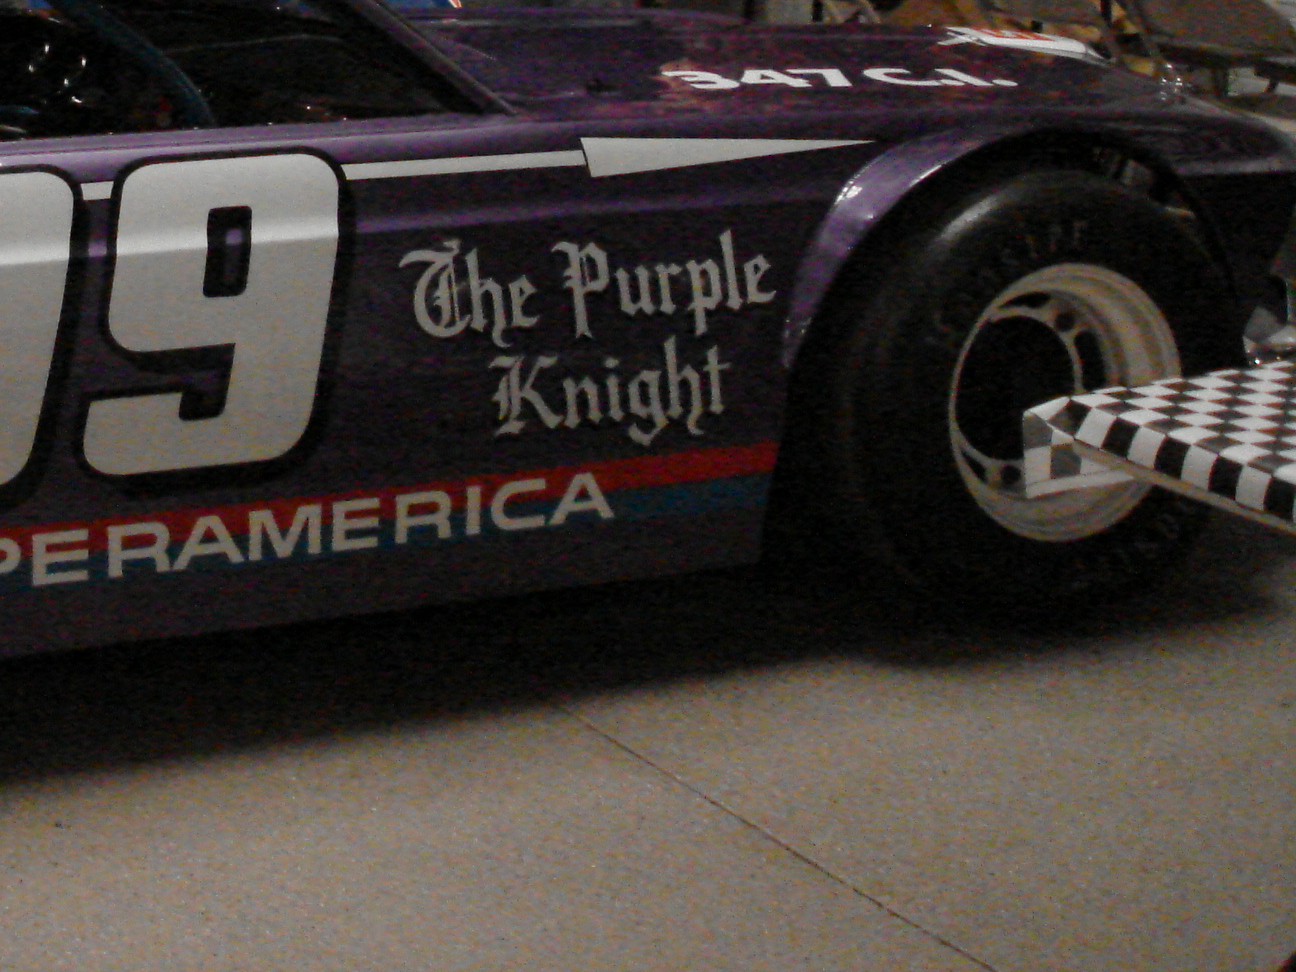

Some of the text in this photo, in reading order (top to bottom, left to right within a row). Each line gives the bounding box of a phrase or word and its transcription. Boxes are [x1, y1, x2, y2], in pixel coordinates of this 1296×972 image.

[661, 66, 853, 90] 347
[398, 229, 778, 348] The Purple
[488, 334, 733, 447] Knight
